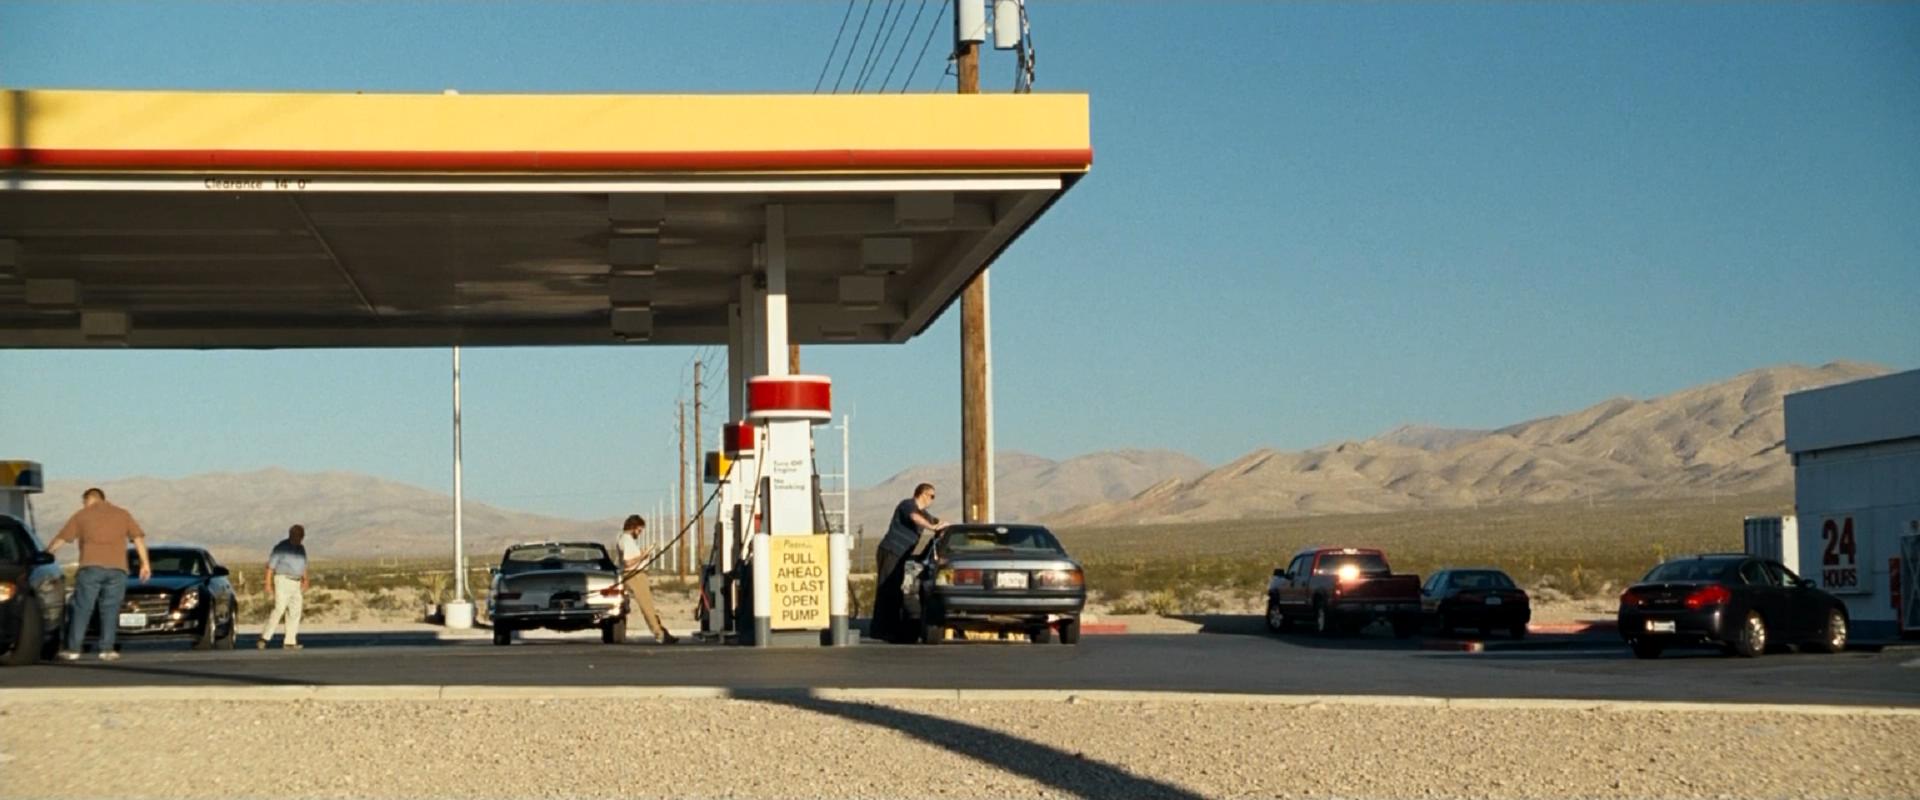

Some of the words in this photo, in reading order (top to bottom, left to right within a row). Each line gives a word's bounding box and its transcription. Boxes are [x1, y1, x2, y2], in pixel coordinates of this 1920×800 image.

[204, 178, 262, 190] Clearance
[1822, 517, 1857, 566] 24
[783, 553, 815, 565] PULL
[777, 566, 823, 579] AHEAD
[1823, 568, 1857, 588] HOURS
[775, 583, 788, 593] to
[791, 580, 825, 592] LAST
[782, 595, 819, 607] OPEN
[782, 609, 819, 621] PUMP
